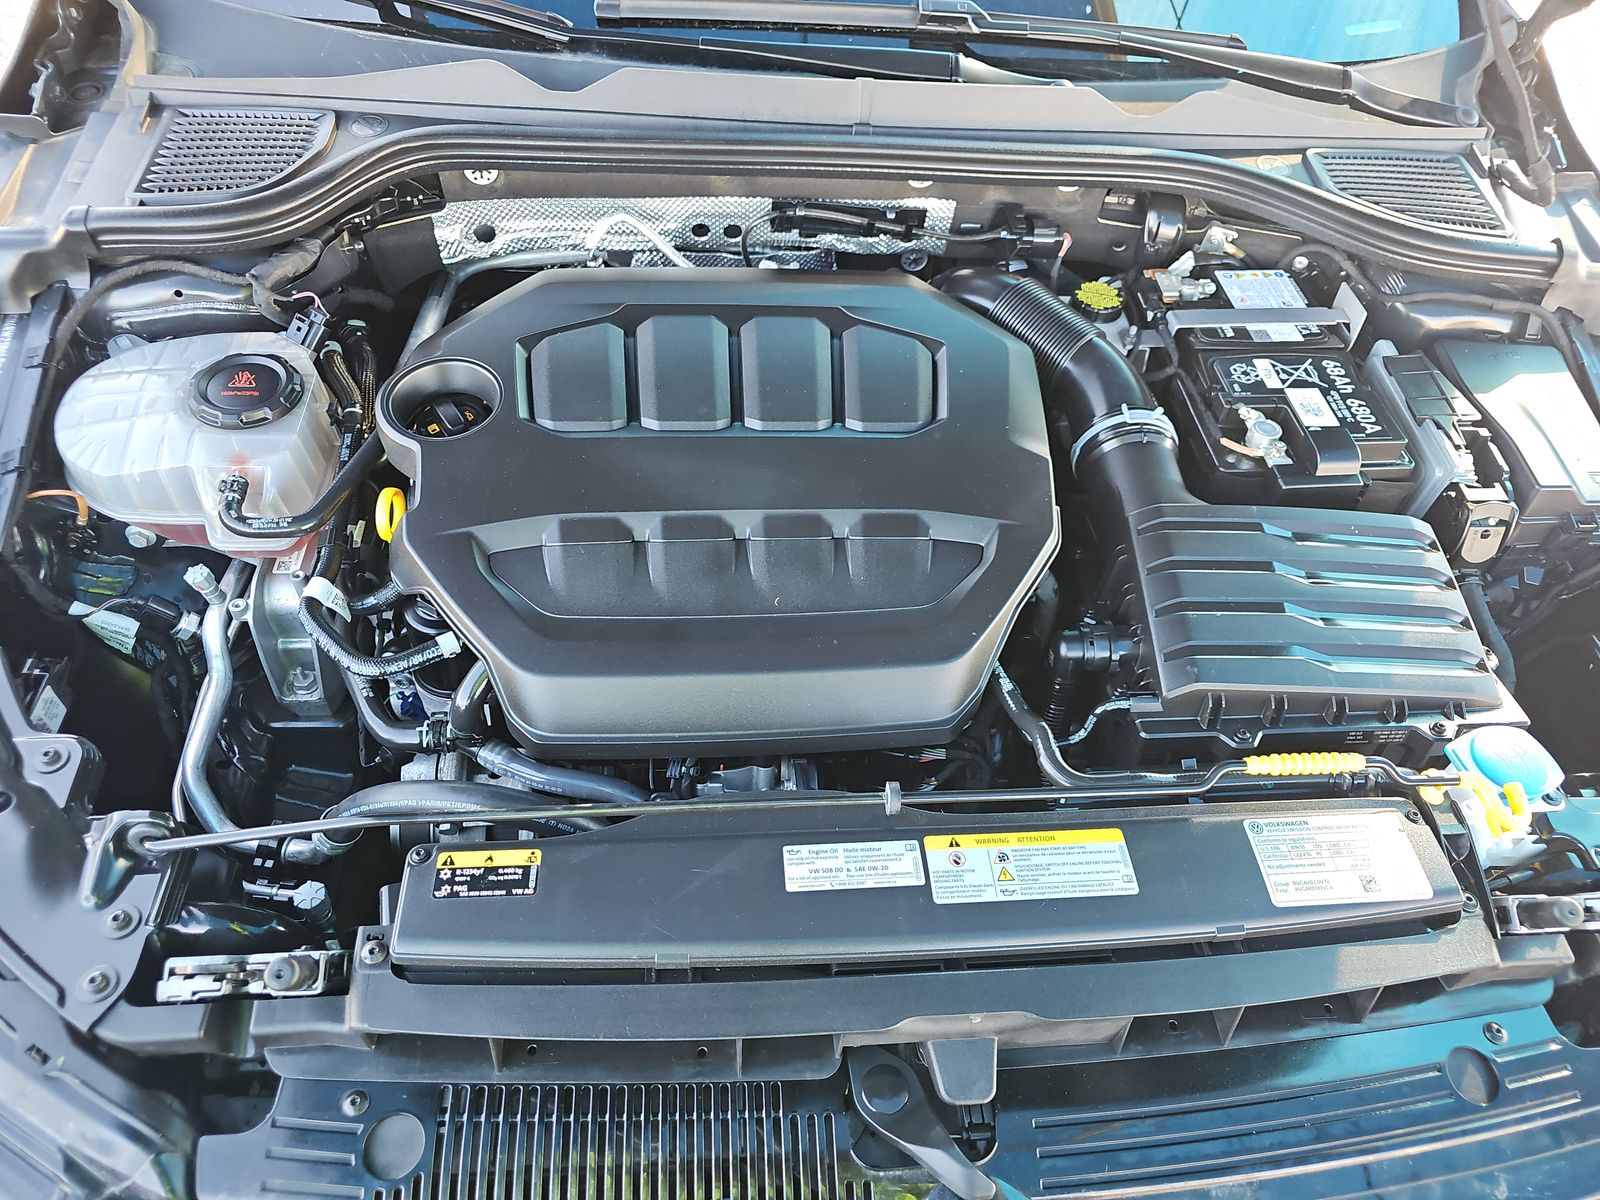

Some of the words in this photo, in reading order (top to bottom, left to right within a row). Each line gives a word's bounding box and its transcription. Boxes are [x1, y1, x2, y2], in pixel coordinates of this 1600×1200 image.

[1321, 359, 1356, 393] 68Ah
[1345, 398, 1383, 434] 680A
[1262, 820, 1309, 828] VOLKSWAGEN
[975, 837, 1010, 845] WARNING
[1017, 835, 1056, 843] ATTENTION
[515, 867, 524, 875] kg
[867, 864, 889, 872] 0W-20
[452, 884, 469, 893] PAG
[523, 887, 535, 895] AG
